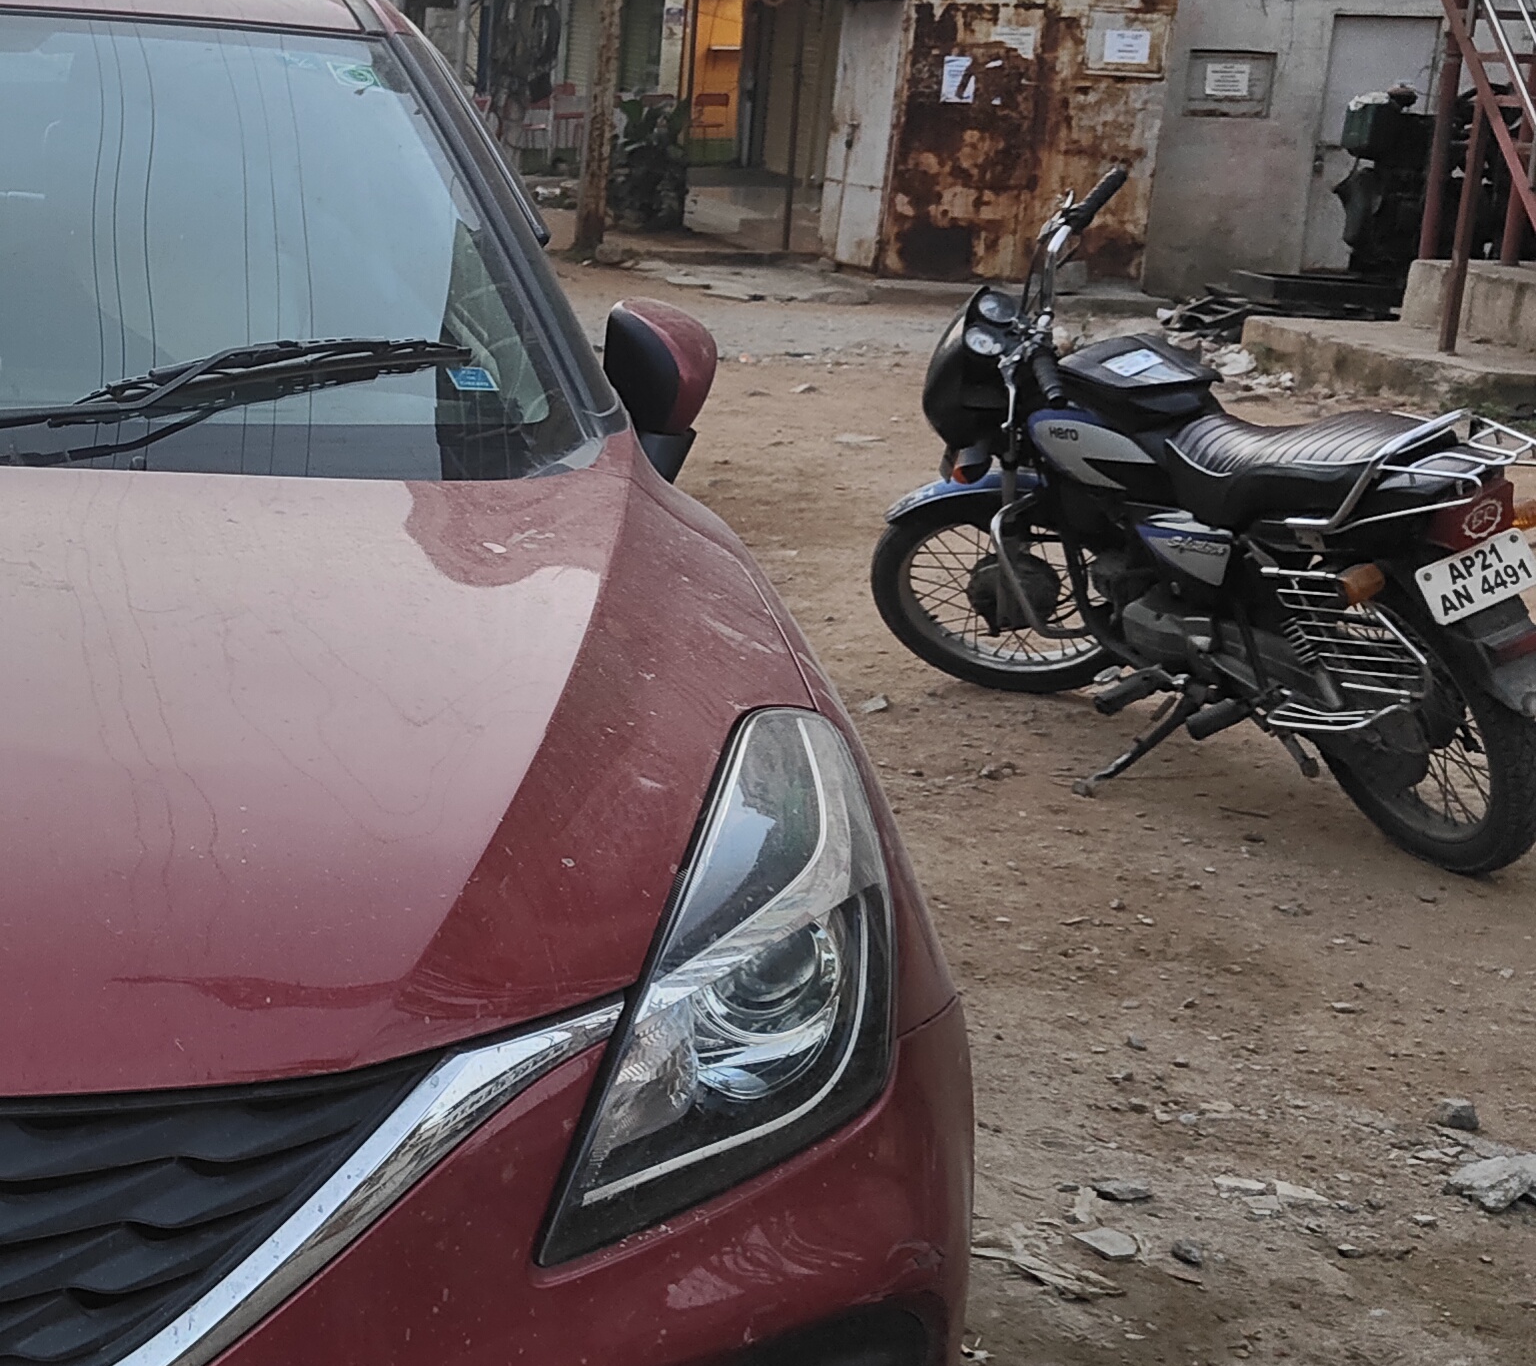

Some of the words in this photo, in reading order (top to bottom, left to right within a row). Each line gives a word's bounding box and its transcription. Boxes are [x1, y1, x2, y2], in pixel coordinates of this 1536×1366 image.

[1440, 585, 1475, 616] AN
[1481, 559, 1532, 595] 4491
[1448, 543, 1503, 585] AP21
